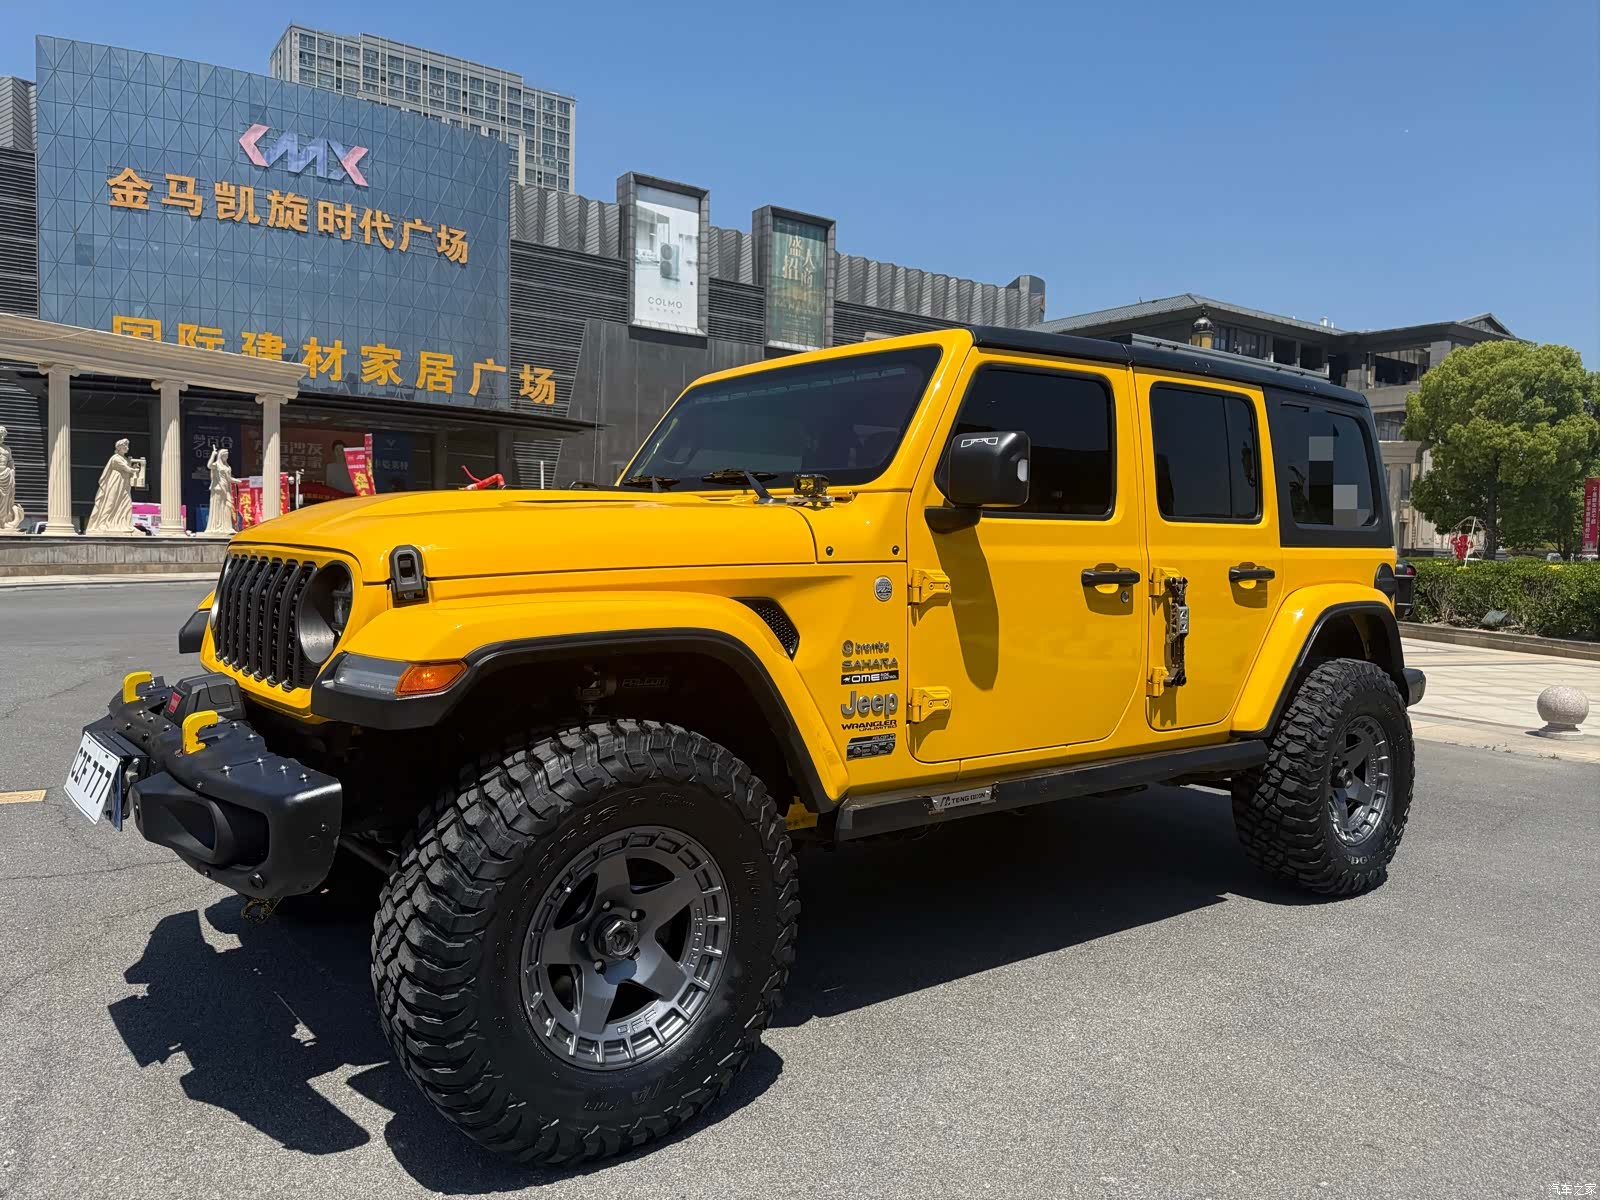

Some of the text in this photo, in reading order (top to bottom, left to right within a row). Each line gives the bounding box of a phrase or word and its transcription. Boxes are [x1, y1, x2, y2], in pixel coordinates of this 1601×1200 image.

[106, 167, 470, 264] 金马凯旋时代广场
[648, 296, 682, 309] COLMO
[193, 434, 233, 450] 梦百合
[842, 657, 898, 671] SAHARA
[851, 673, 880, 683] OME
[841, 690, 898, 717] Jeep
[841, 719, 897, 730] WRANGLER
